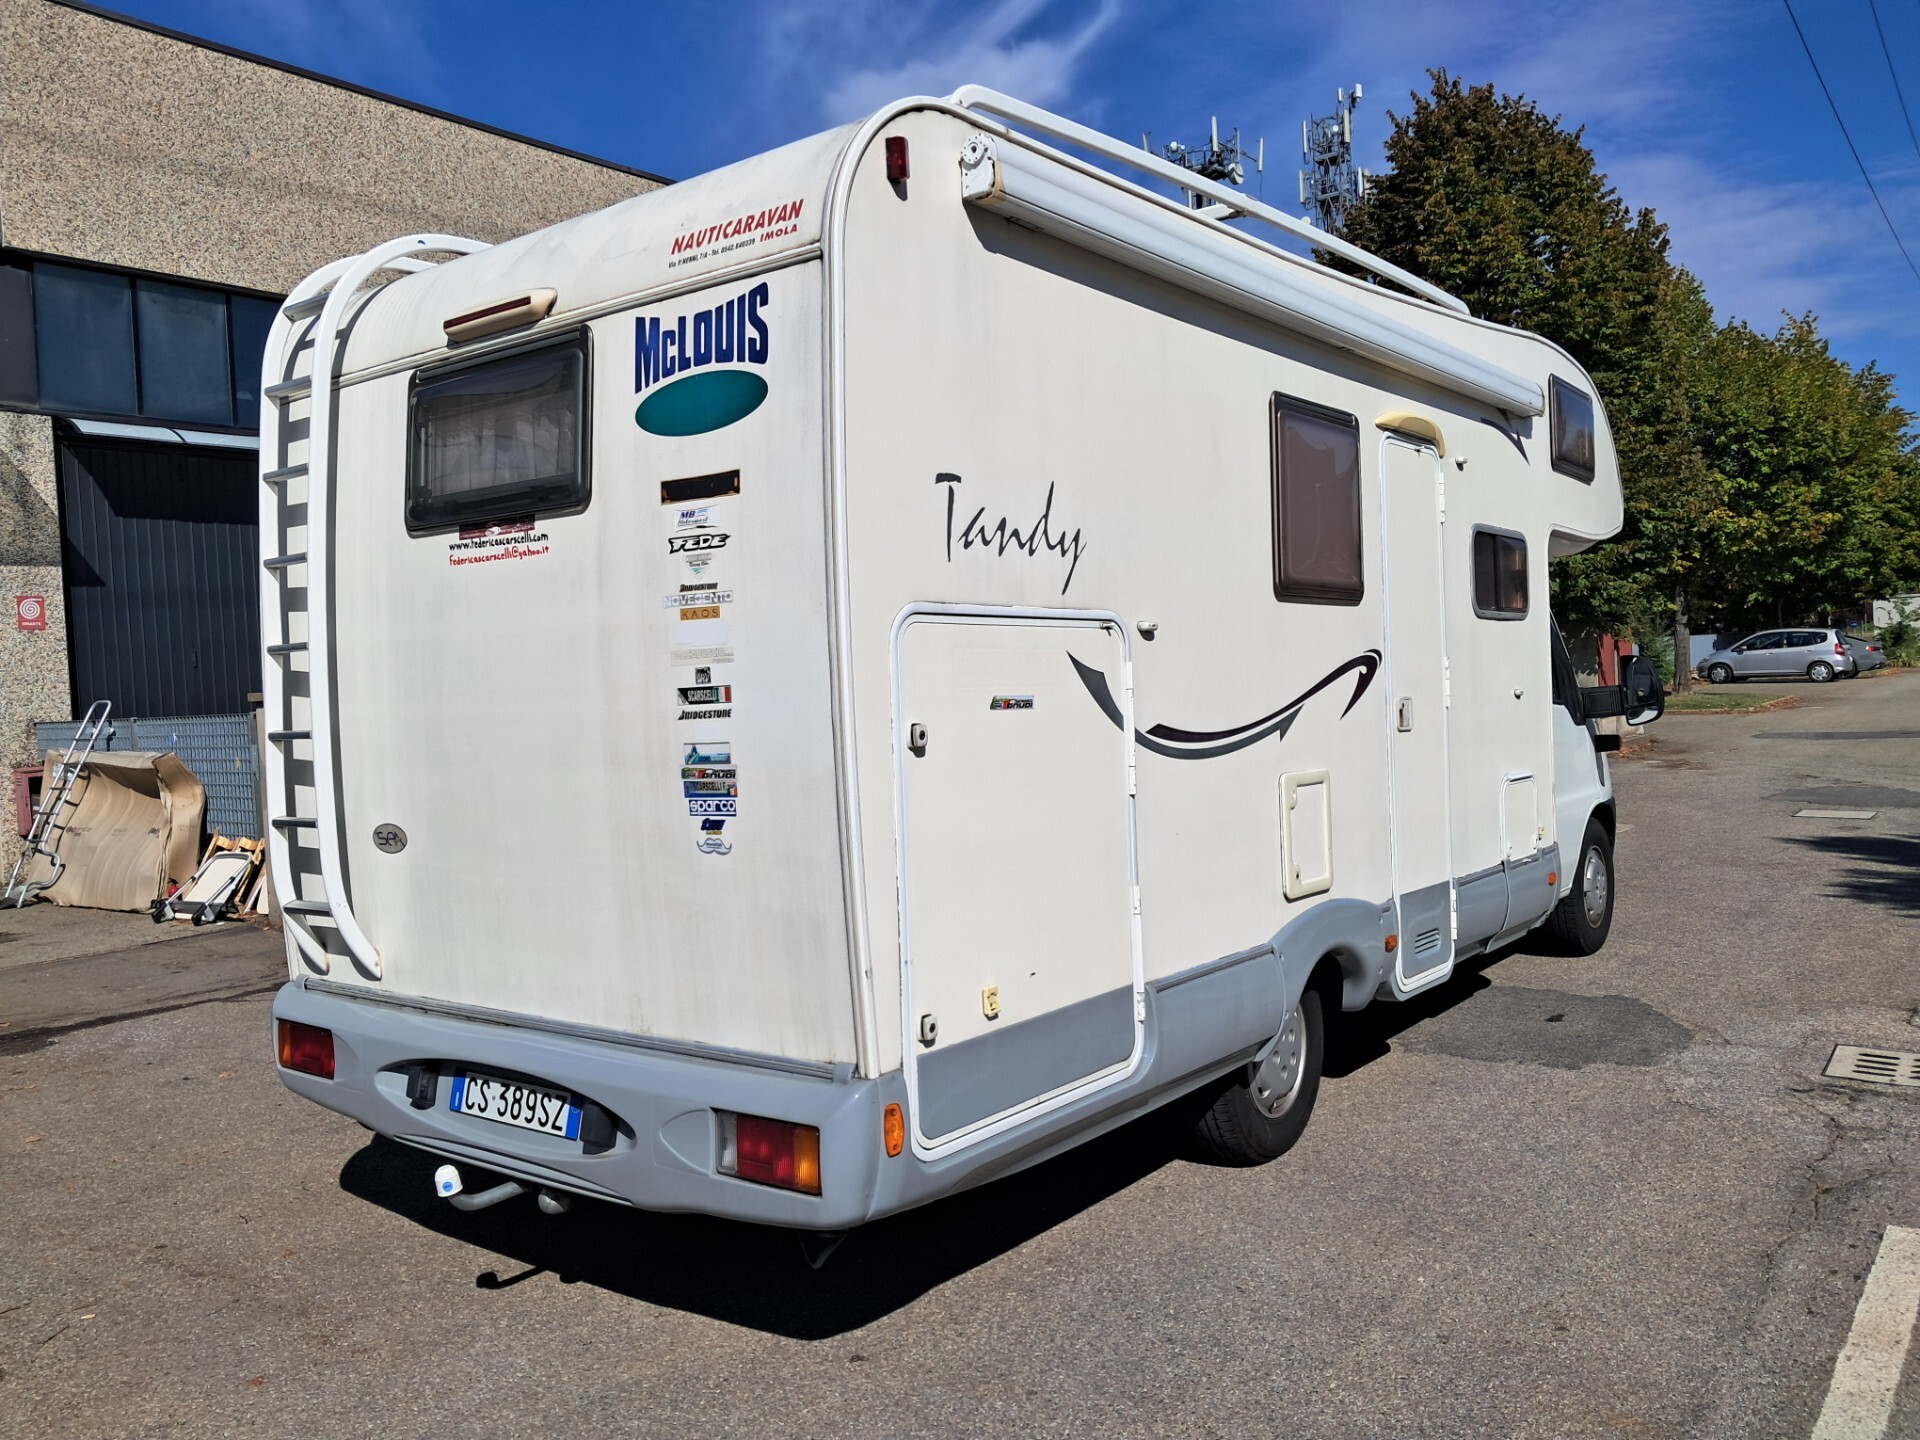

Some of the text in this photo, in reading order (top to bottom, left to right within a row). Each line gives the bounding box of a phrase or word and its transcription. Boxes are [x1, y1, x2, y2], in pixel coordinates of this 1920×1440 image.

[671, 199, 804, 255] NAUTICARAVAN
[760, 224, 798, 242] IMOLA
[635, 282, 769, 395] McLOUIS
[681, 510, 696, 518] MB
[935, 472, 1088, 596] Tandy
[682, 608, 718, 618] KAOS
[690, 800, 736, 815] sparco
[465, 1077, 491, 1113] CS
